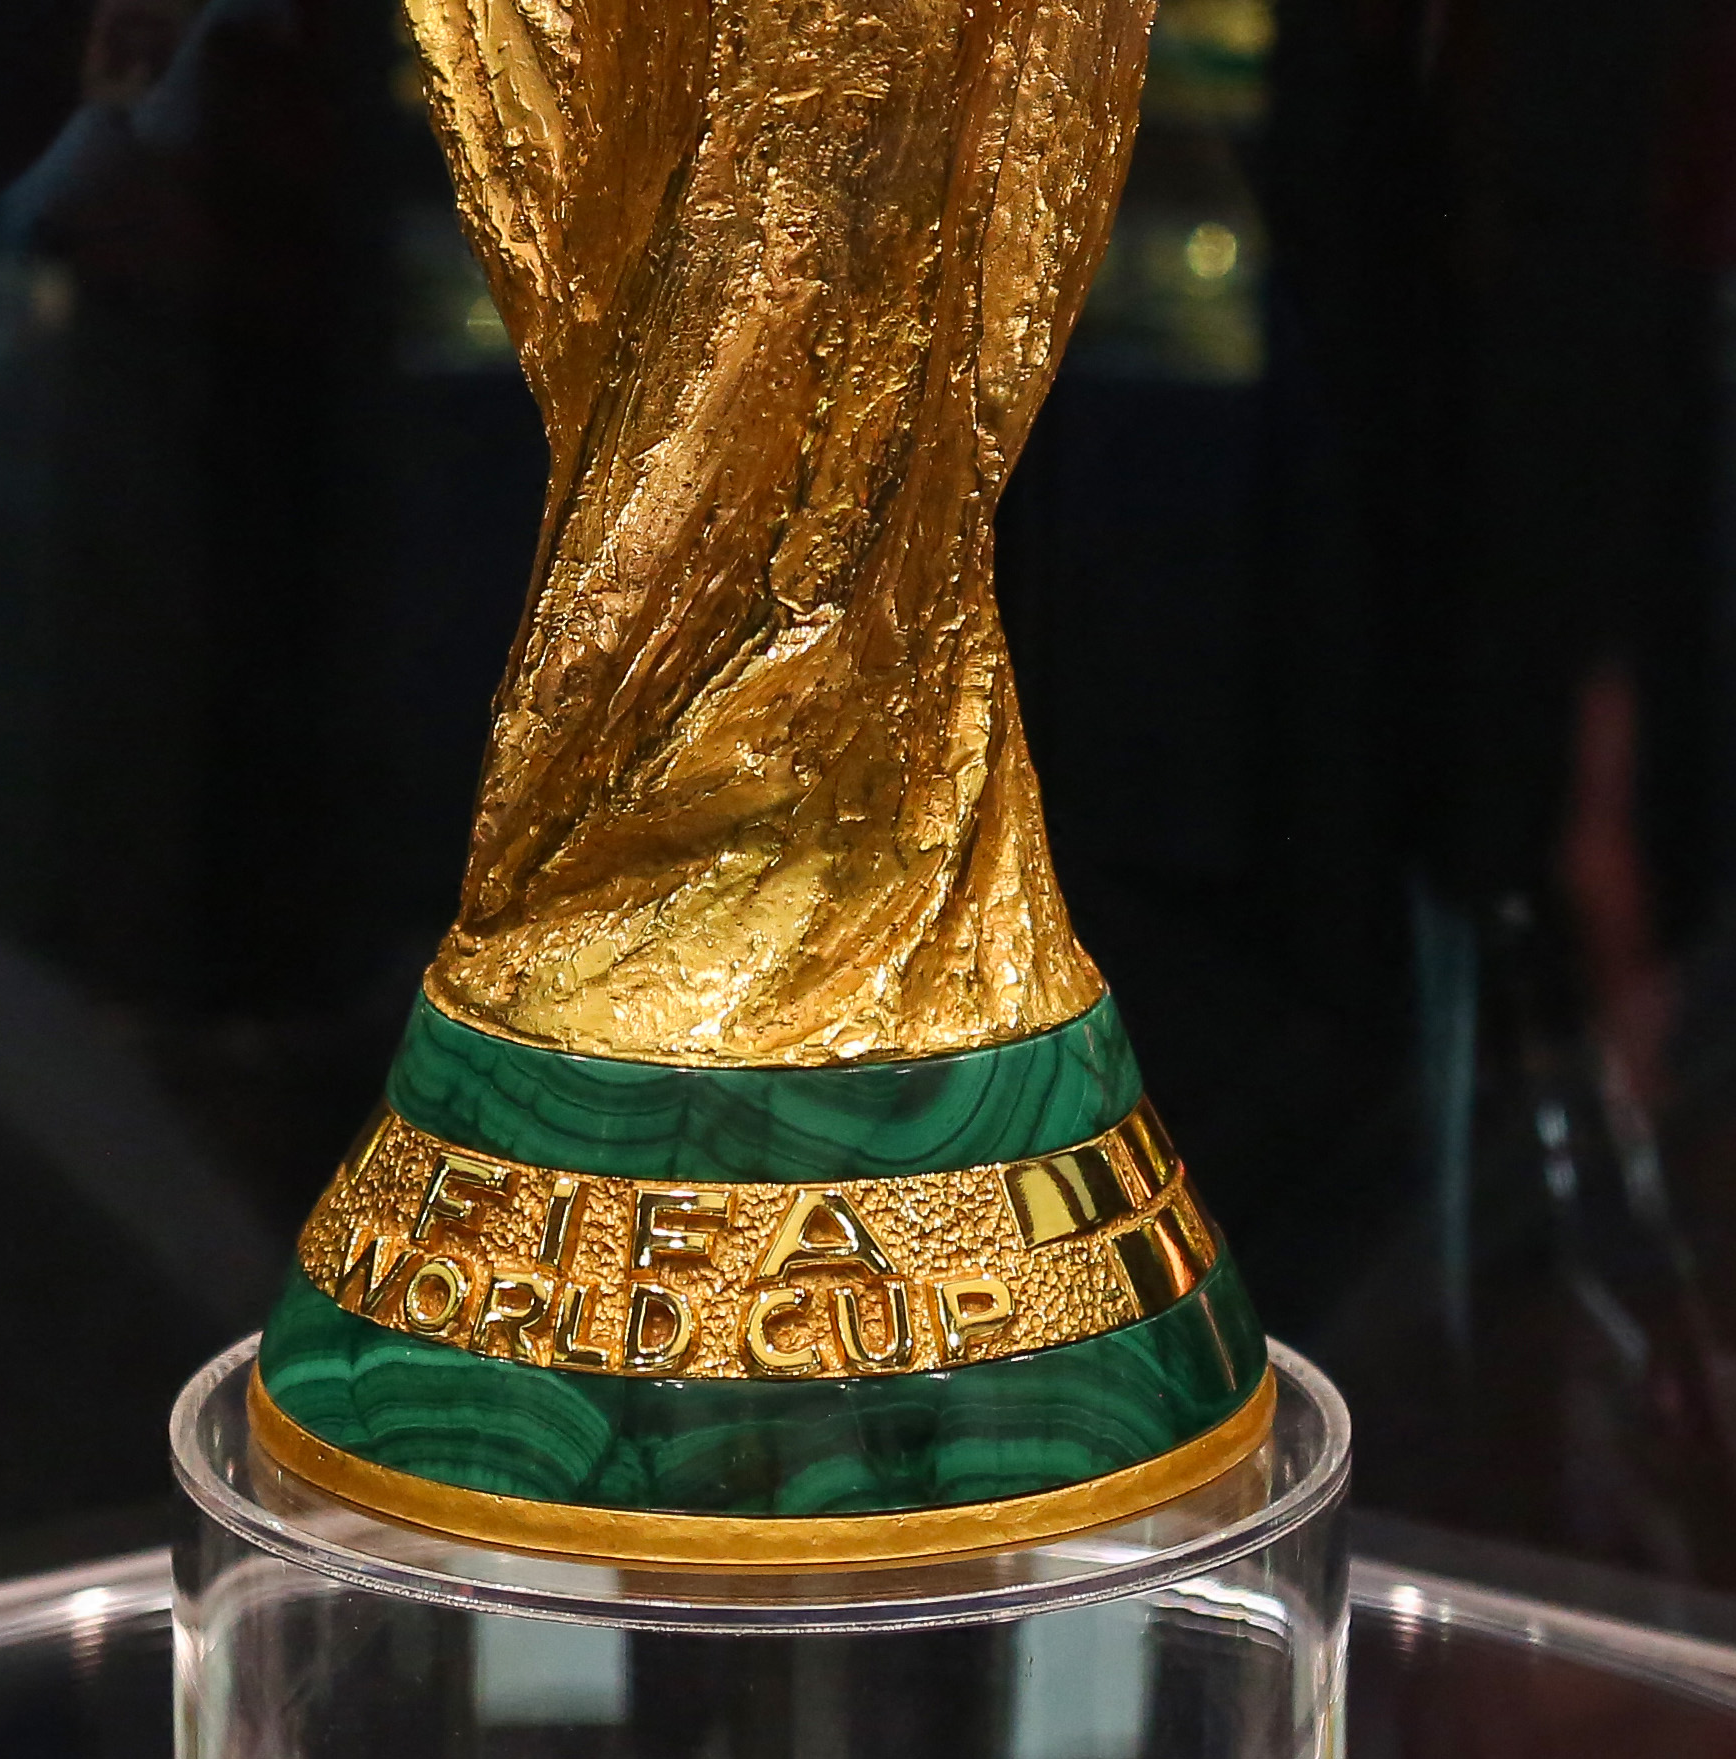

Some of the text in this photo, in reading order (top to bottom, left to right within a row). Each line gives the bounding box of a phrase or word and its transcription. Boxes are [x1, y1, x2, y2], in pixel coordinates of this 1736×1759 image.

[412, 1152, 893, 1280] FIFA
[335, 1238, 1015, 1371] WORLD CUP
